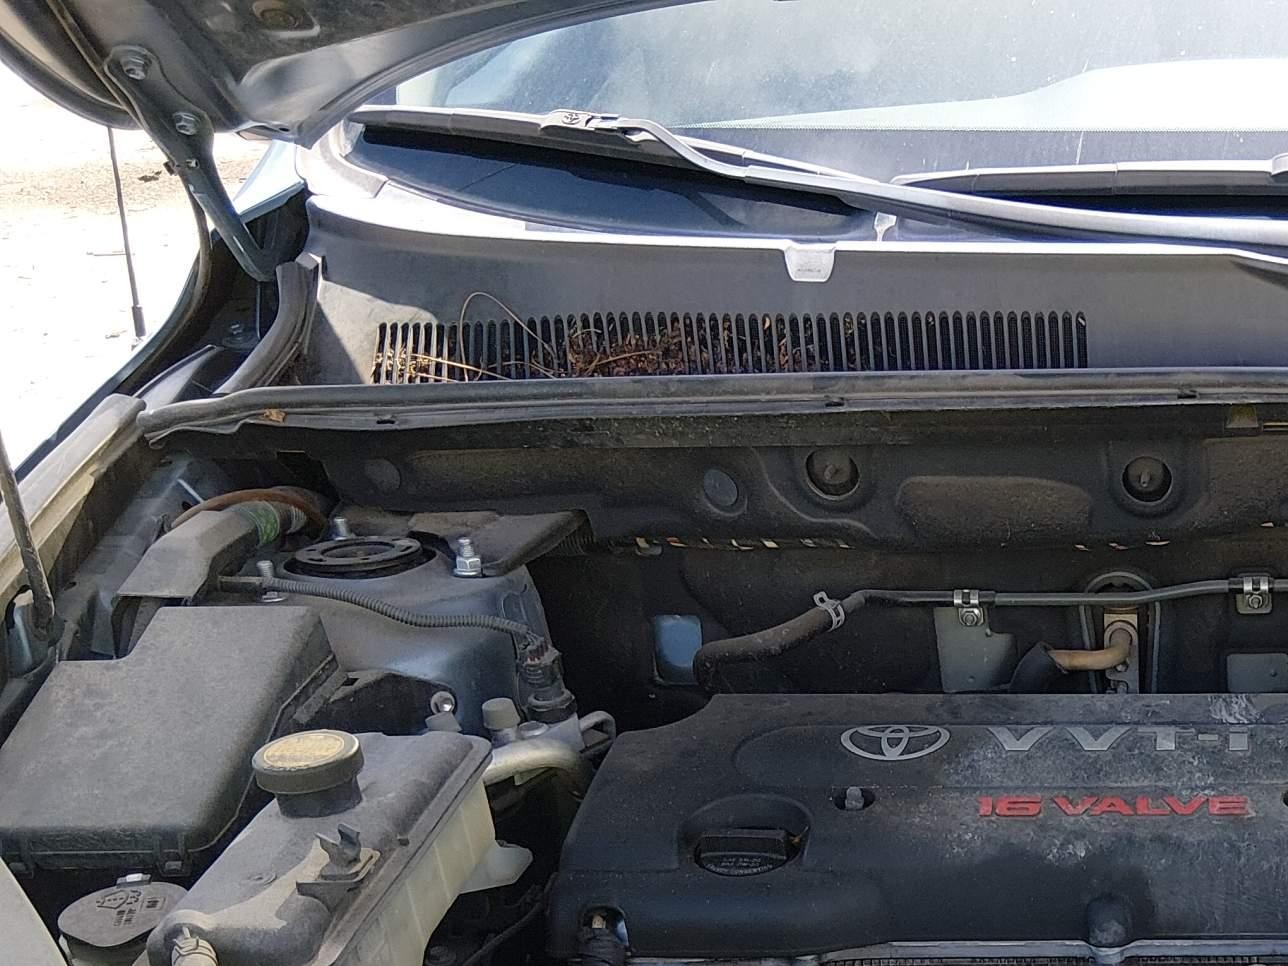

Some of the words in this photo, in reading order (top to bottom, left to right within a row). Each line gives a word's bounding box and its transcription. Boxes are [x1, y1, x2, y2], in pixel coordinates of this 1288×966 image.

[989, 725, 1249, 752] VVT-i
[978, 794, 1043, 818] 16
[1051, 794, 1254, 817] VALVE
